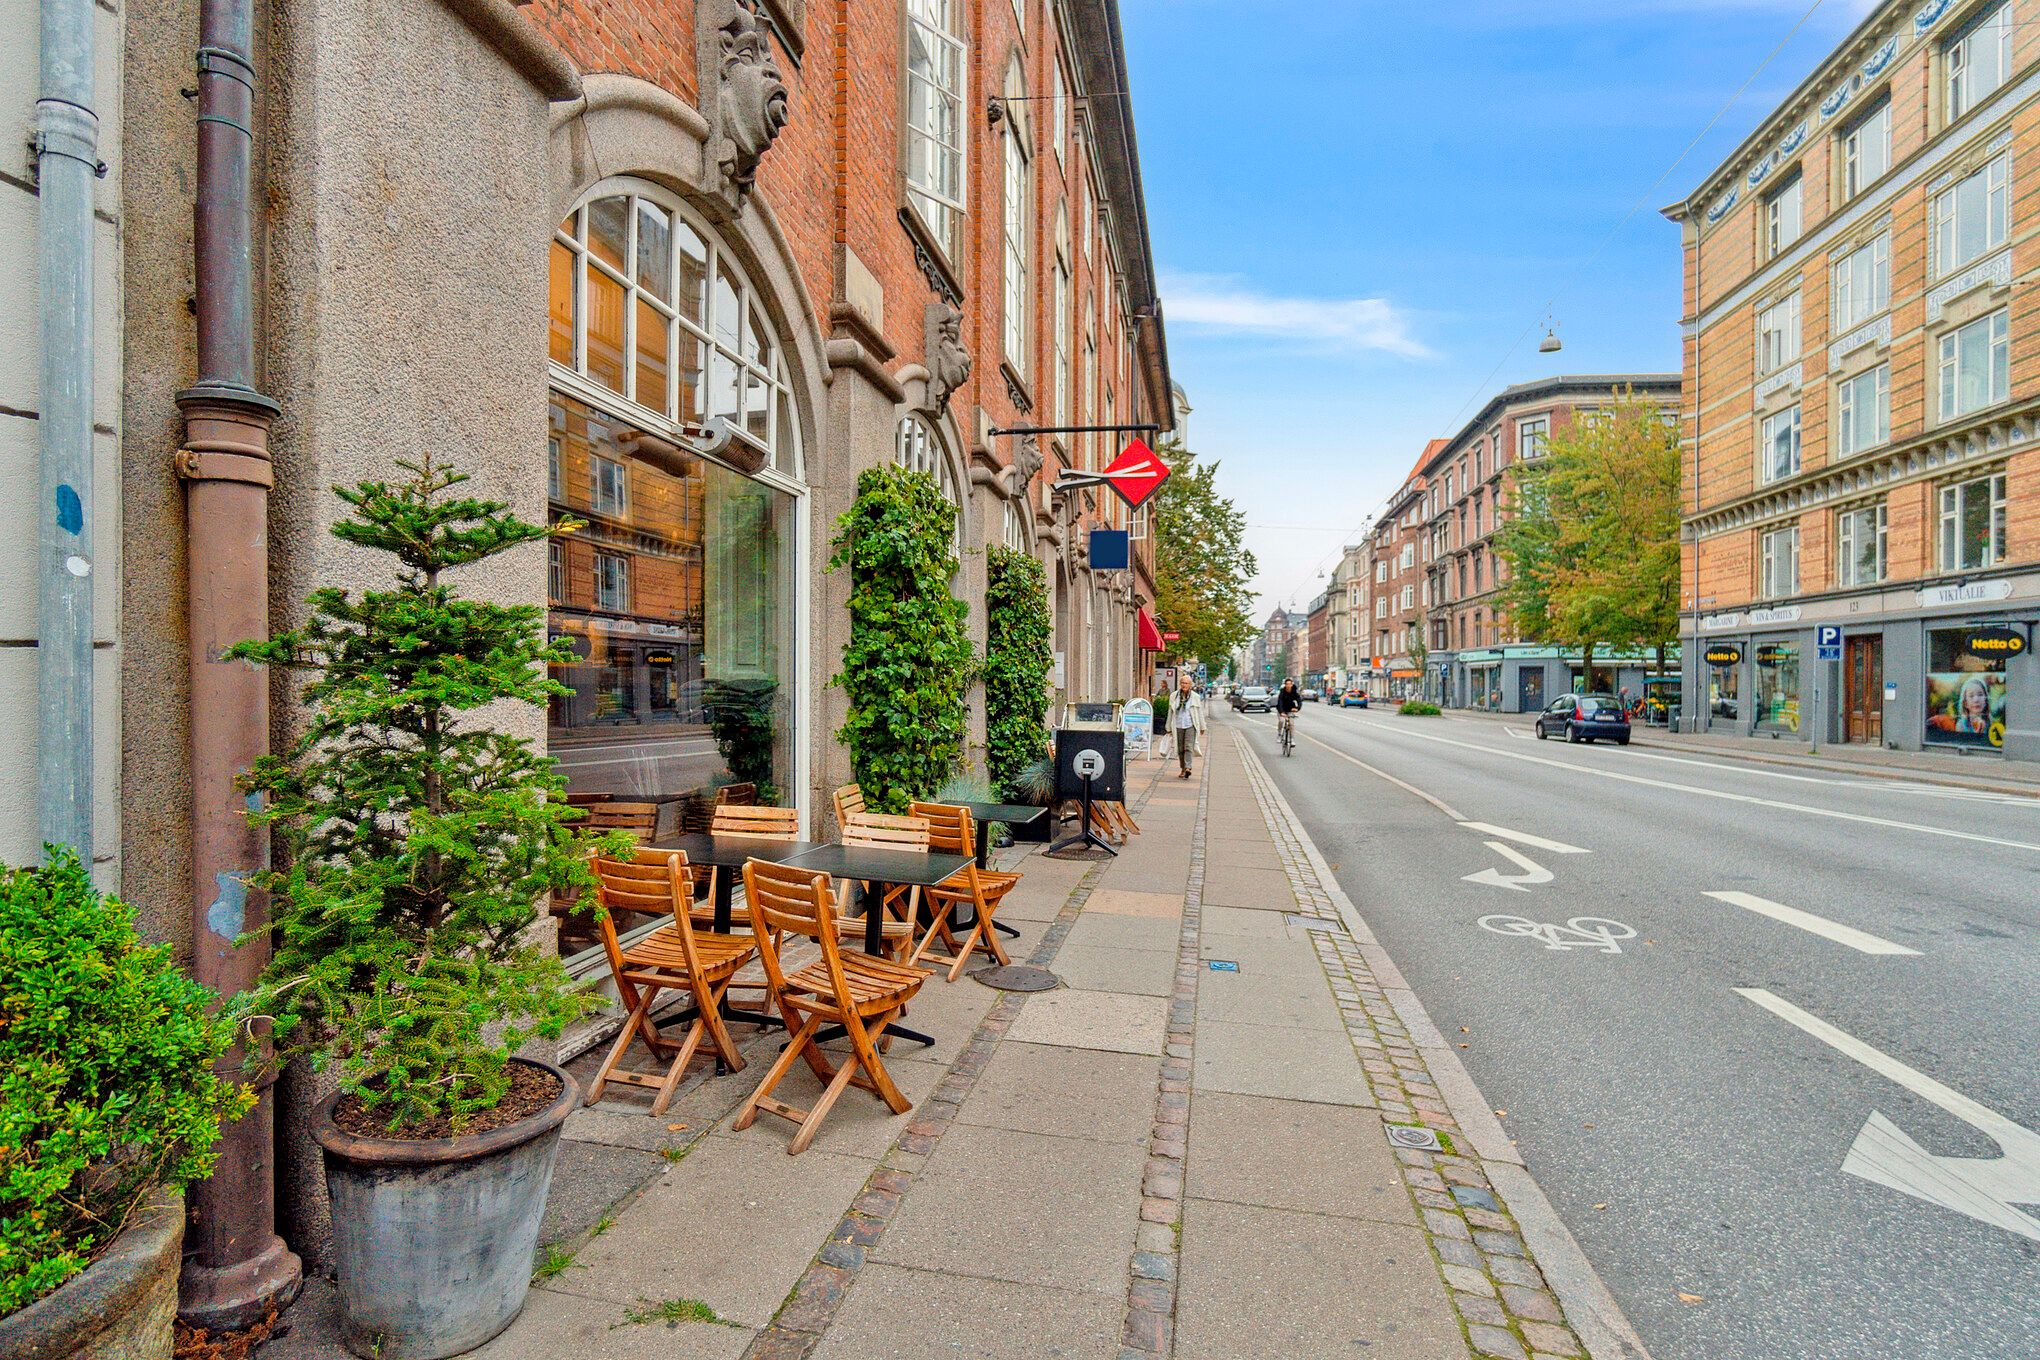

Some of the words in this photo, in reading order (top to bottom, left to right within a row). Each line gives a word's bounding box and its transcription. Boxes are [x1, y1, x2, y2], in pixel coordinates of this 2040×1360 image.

[1939, 586, 1986, 602] VIKTUALIE
[1849, 601, 1859, 612] 123
[1822, 627, 1837, 645] P
[1972, 639, 2008, 650] Netto
[1707, 652, 1729, 661] Netto
[1441, 663, 1447, 671] P
